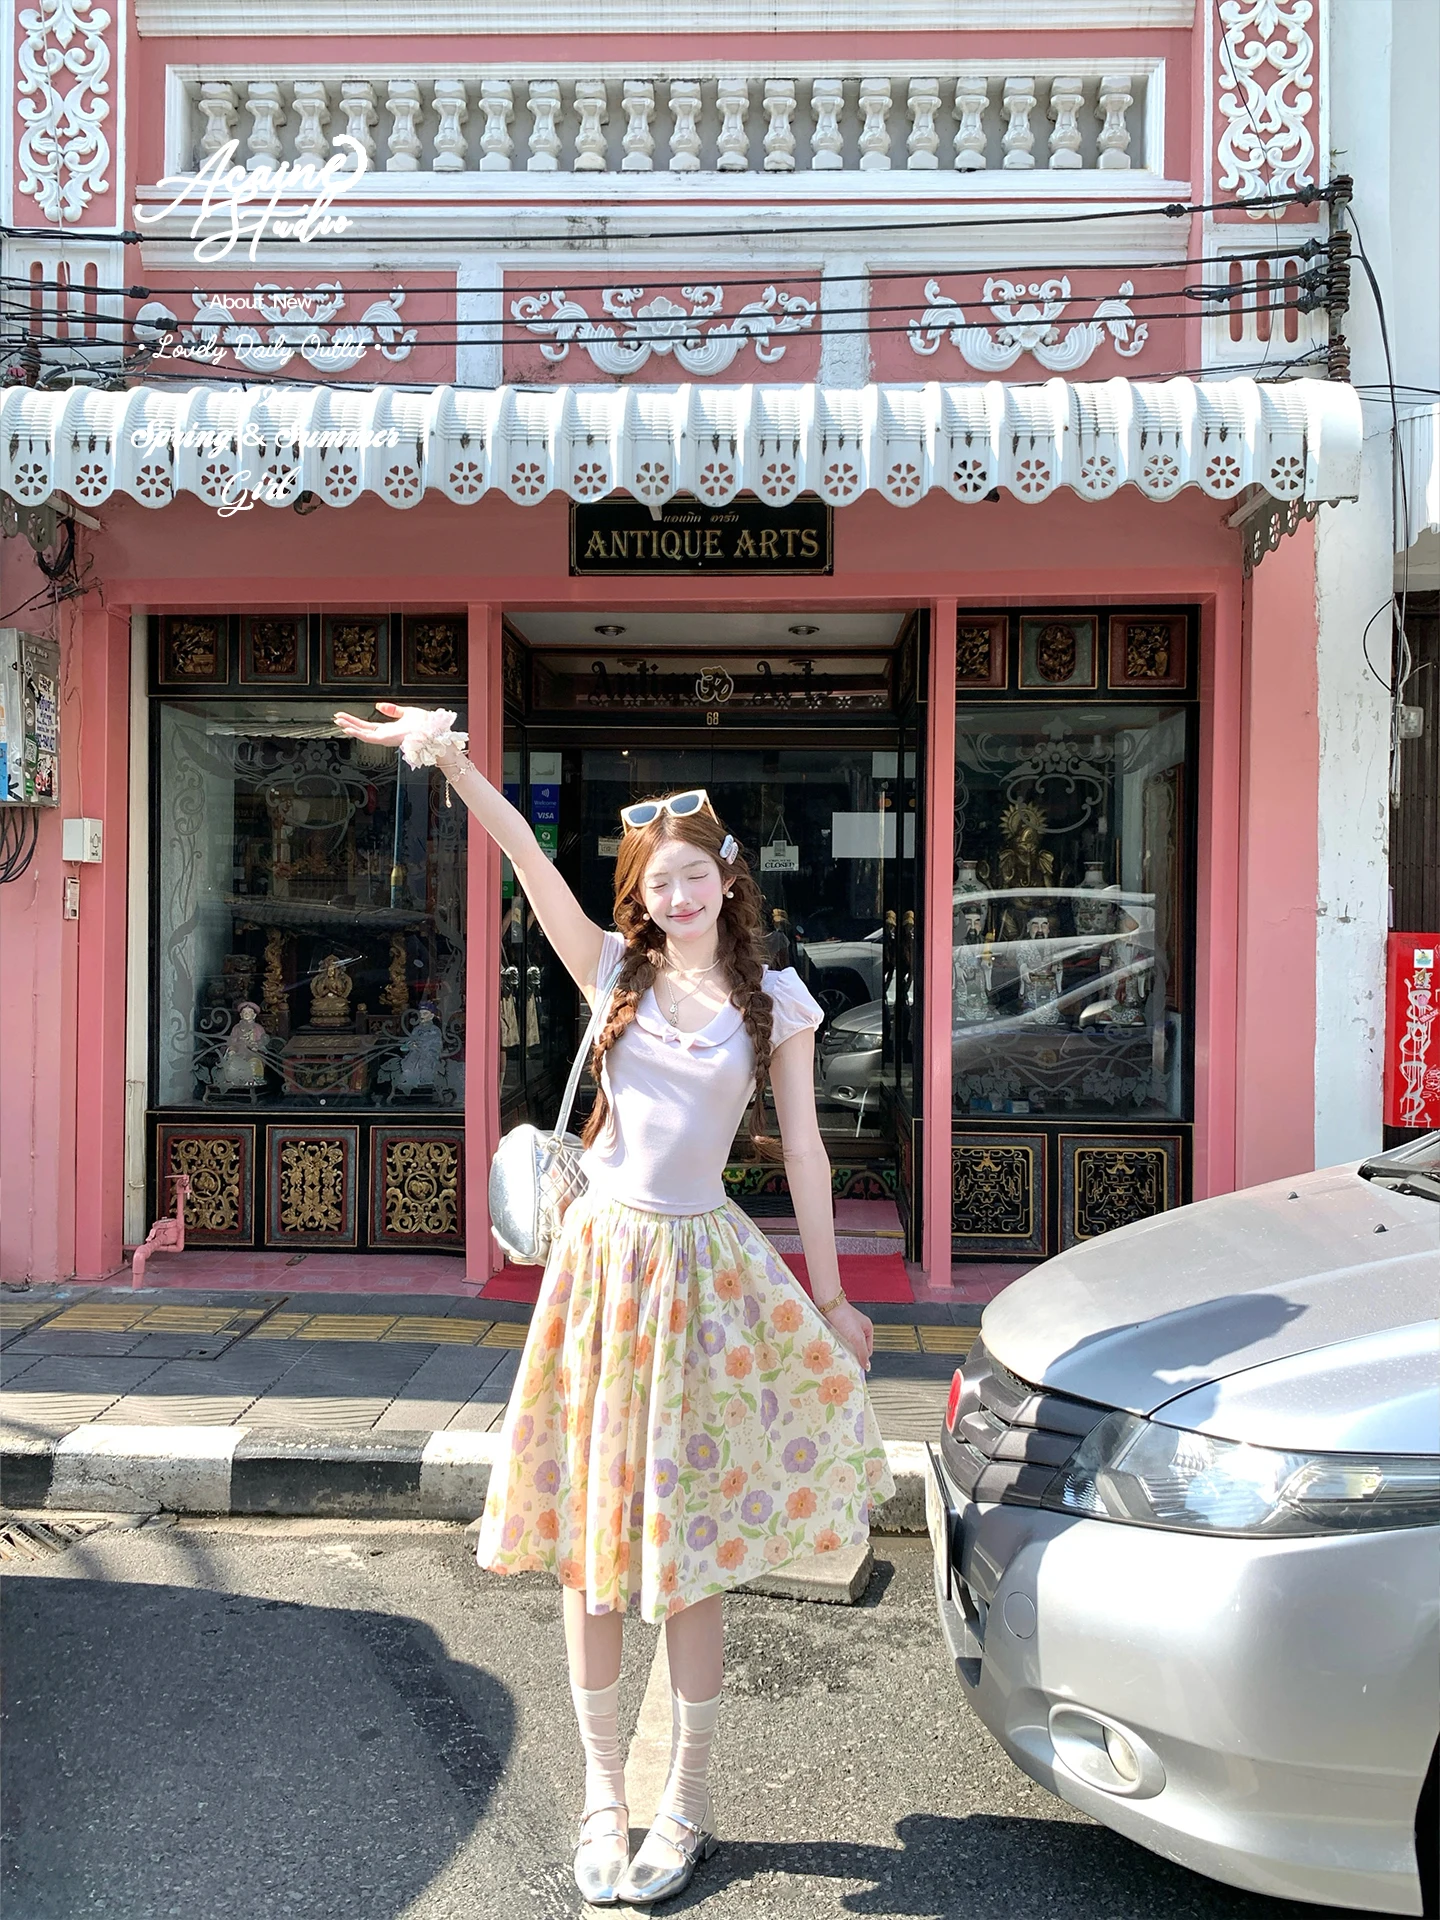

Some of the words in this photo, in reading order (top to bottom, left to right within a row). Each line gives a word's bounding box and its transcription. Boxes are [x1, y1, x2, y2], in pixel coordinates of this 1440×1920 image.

[584, 529, 725, 561] ANTIQUE
[733, 528, 819, 560] ARTS
[706, 711, 720, 726] 68
